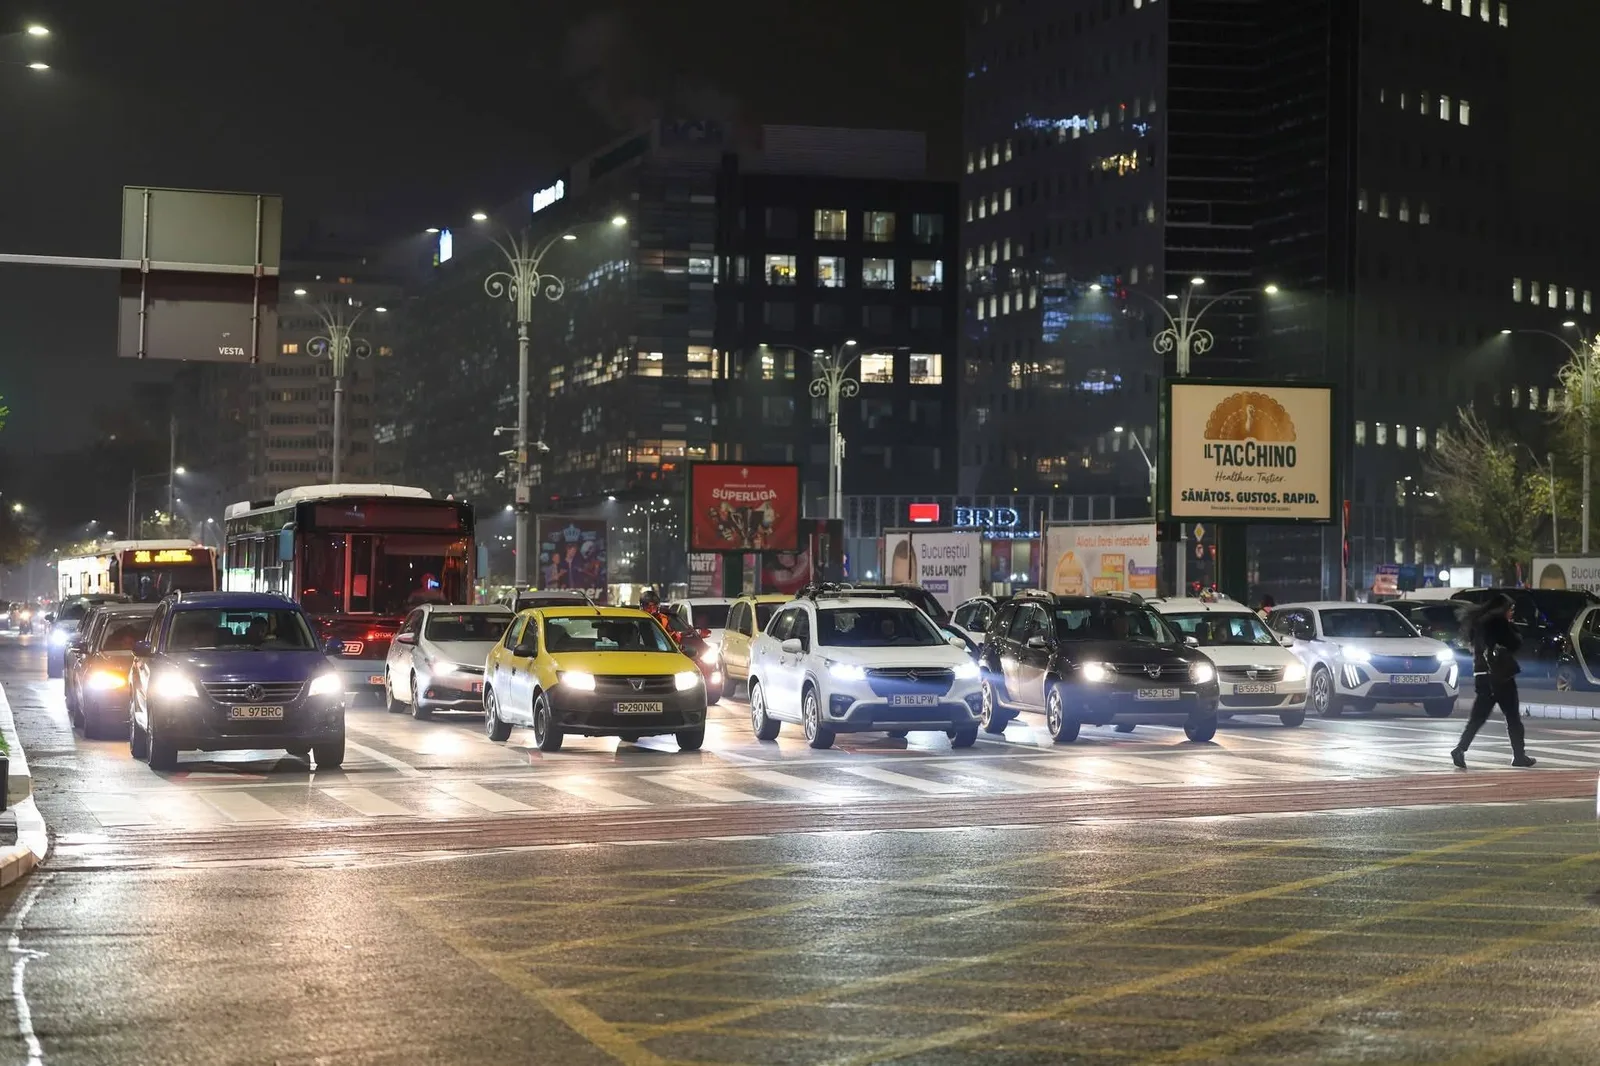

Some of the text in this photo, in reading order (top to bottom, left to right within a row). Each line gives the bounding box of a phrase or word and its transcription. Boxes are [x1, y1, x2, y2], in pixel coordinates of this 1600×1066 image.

[218, 346, 245, 356] VESTA
[1204, 441, 1297, 468] IL TACCHINO
[1214, 469, 1287, 484] Healthier. Tastier.
[712, 487, 777, 502] SUPERLIGA
[1181, 487, 1319, 505] SĂNĂTOS. GUSTOS. RAPID.
[953, 506, 1019, 527] BRD
[921, 542, 970, 562] Bucureștiul
[921, 564, 967, 577] PUS LA PUNCT
[232, 707, 245, 717] GL
